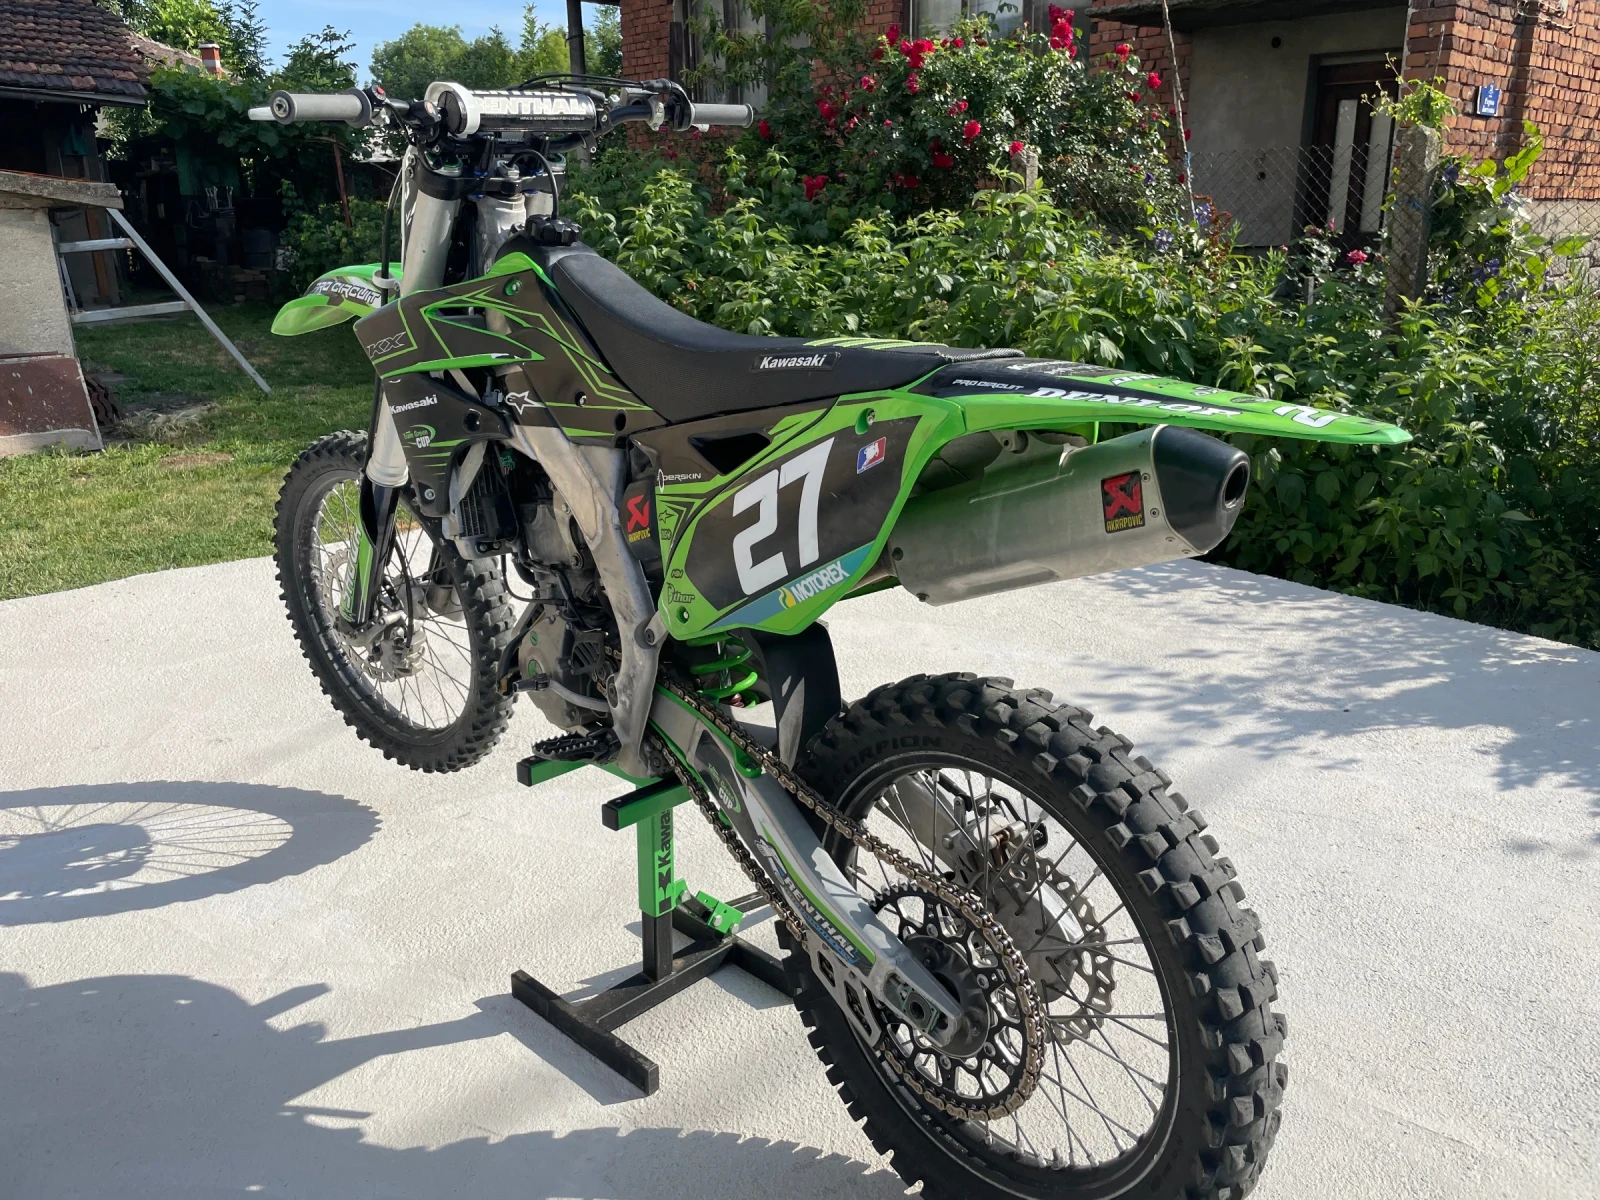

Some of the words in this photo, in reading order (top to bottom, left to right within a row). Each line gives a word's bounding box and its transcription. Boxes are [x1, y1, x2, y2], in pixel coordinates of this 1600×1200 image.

[475, 96, 587, 115] RENTHAL
[331, 282, 381, 304] CIRCUIT
[366, 331, 406, 359] KX
[760, 354, 827, 369] Kawasaki
[952, 379, 977, 387] PRO
[977, 381, 1025, 391] CIRCUIT
[389, 394, 438, 415] Kawasaki
[1023, 386, 1243, 416] DUNLOP
[415, 435, 431, 449] CUP
[732, 436, 835, 596] 27
[790, 560, 851, 603] MOTOREX
[718, 787, 734, 810] CUP
[657, 809, 672, 869] Kawa
[784, 876, 855, 958] RENTHAL
